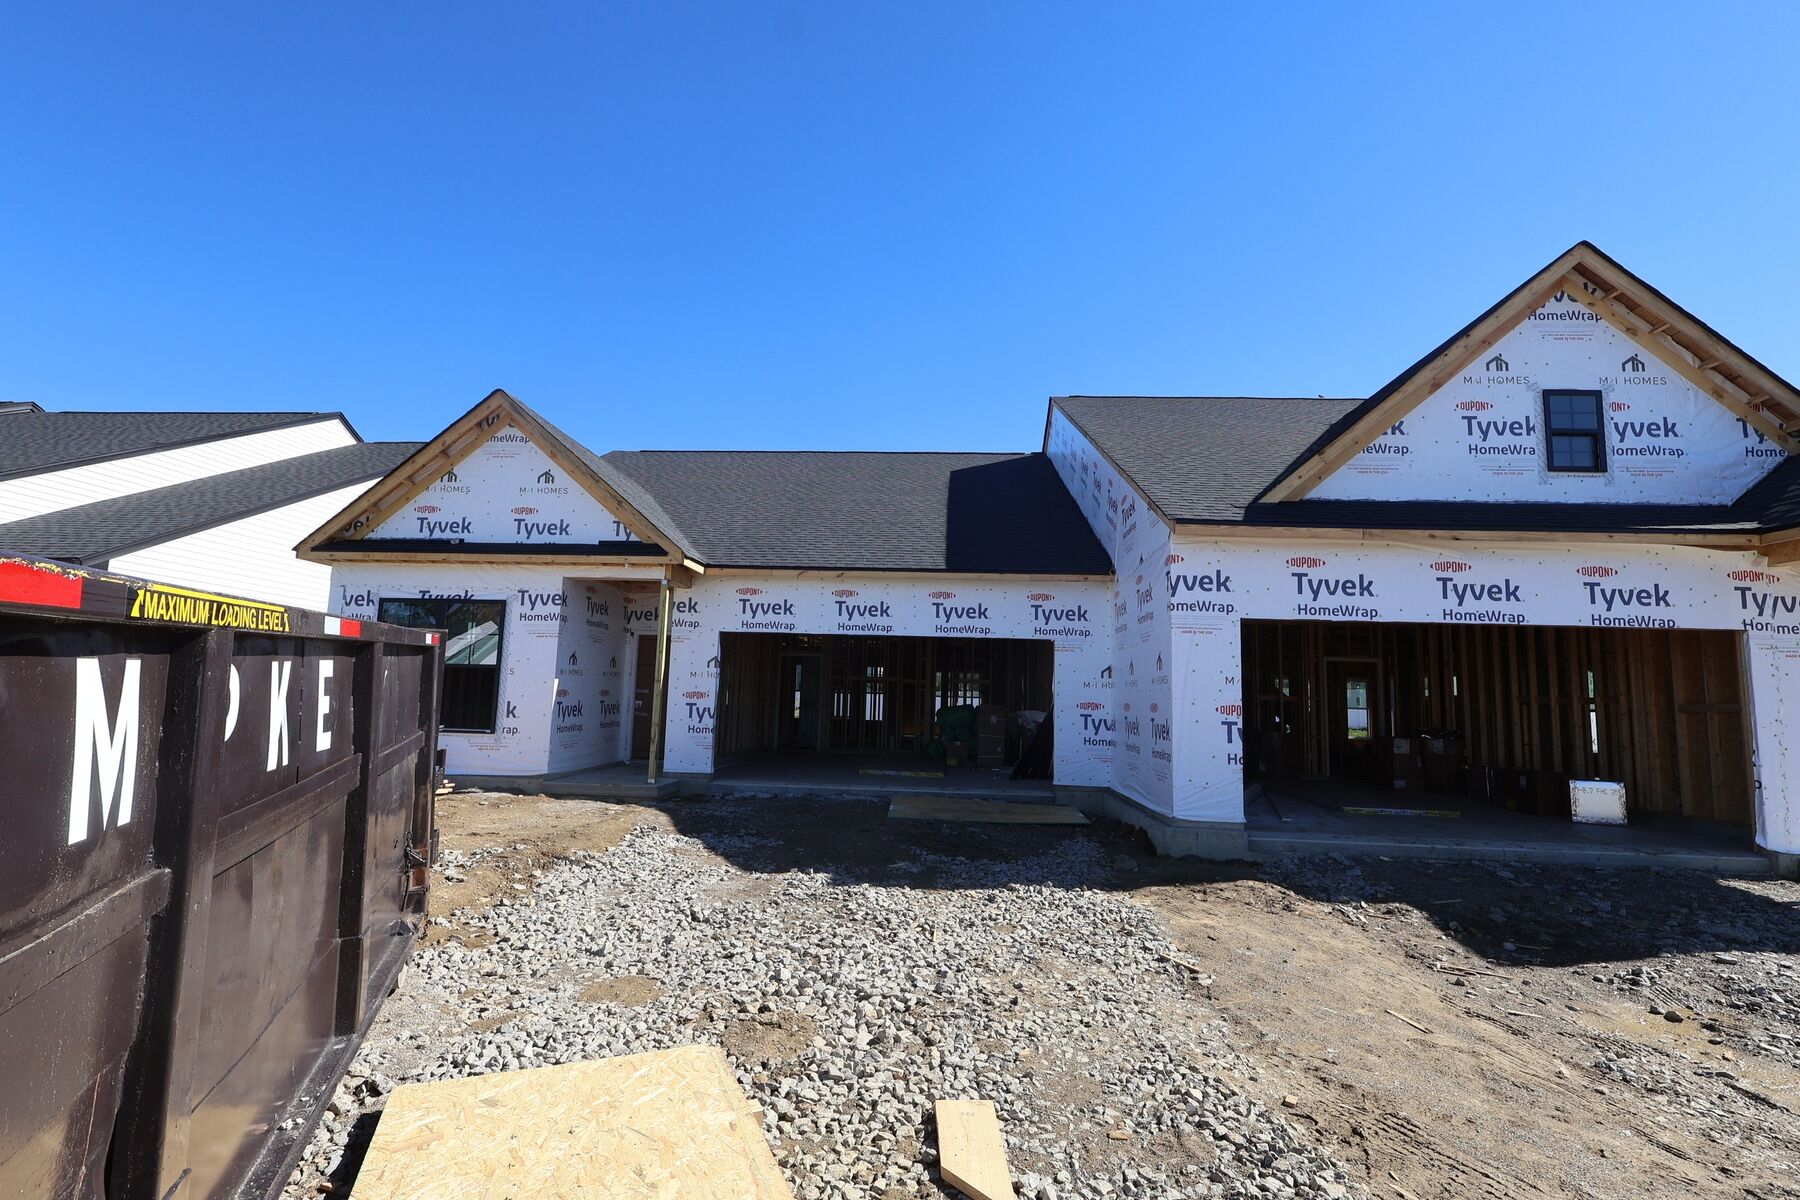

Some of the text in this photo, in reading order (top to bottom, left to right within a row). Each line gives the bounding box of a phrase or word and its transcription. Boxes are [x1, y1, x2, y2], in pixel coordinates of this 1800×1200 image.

[1488, 376, 1530, 385] HOMES
[1624, 376, 1667, 386] HOMES
[1460, 401, 1490, 412] DUPONT
[1461, 416, 1536, 442] Tyvek
[1611, 417, 1680, 443] yvek
[417, 506, 438, 514] DUPONT
[514, 507, 536, 515] DUPONT
[416, 516, 472, 536] Tyvek
[514, 518, 570, 540] Tyvek
[1290, 557, 1322, 568] DUPONT
[1435, 561, 1468, 572] DUPONT
[1581, 566, 1614, 578] DUPONT
[1166, 570, 1232, 598] Tyvek
[1292, 572, 1374, 601] Tyvek
[1436, 576, 1521, 606] Tyvek
[738, 588, 760, 596] DUPONT
[834, 590, 856, 598] DUPONT
[932, 592, 954, 600] DUPONT
[1030, 594, 1052, 602] DUPONT
[1583, 582, 1671, 612] Tyvek
[518, 590, 568, 610] Tyvek
[586, 596, 609, 618] Tyvek
[144, 592, 284, 632] MAXIMUM LOADING LEVEL
[738, 599, 794, 618] Tyvek
[835, 600, 891, 621] Tyvek
[932, 602, 988, 622] Tyvek
[1030, 604, 1088, 626] Tyvek
[1298, 604, 1378, 620] HomeWrap
[520, 612, 568, 622] HomeWrap
[1442, 608, 1526, 624] HomeWrap
[1591, 614, 1676, 628] HomeWrap
[742, 620, 796, 632] HomeWrap
[838, 622, 892, 634] HomeWrap
[935, 624, 991, 636] HomeWrap
[1034, 626, 1091, 638] HomeWrap
[686, 692, 707, 700] DUPONT
[556, 700, 584, 722] Tyvek
[1080, 702, 1102, 711] DUPONT
[1150, 717, 1171, 745] Tyvek
